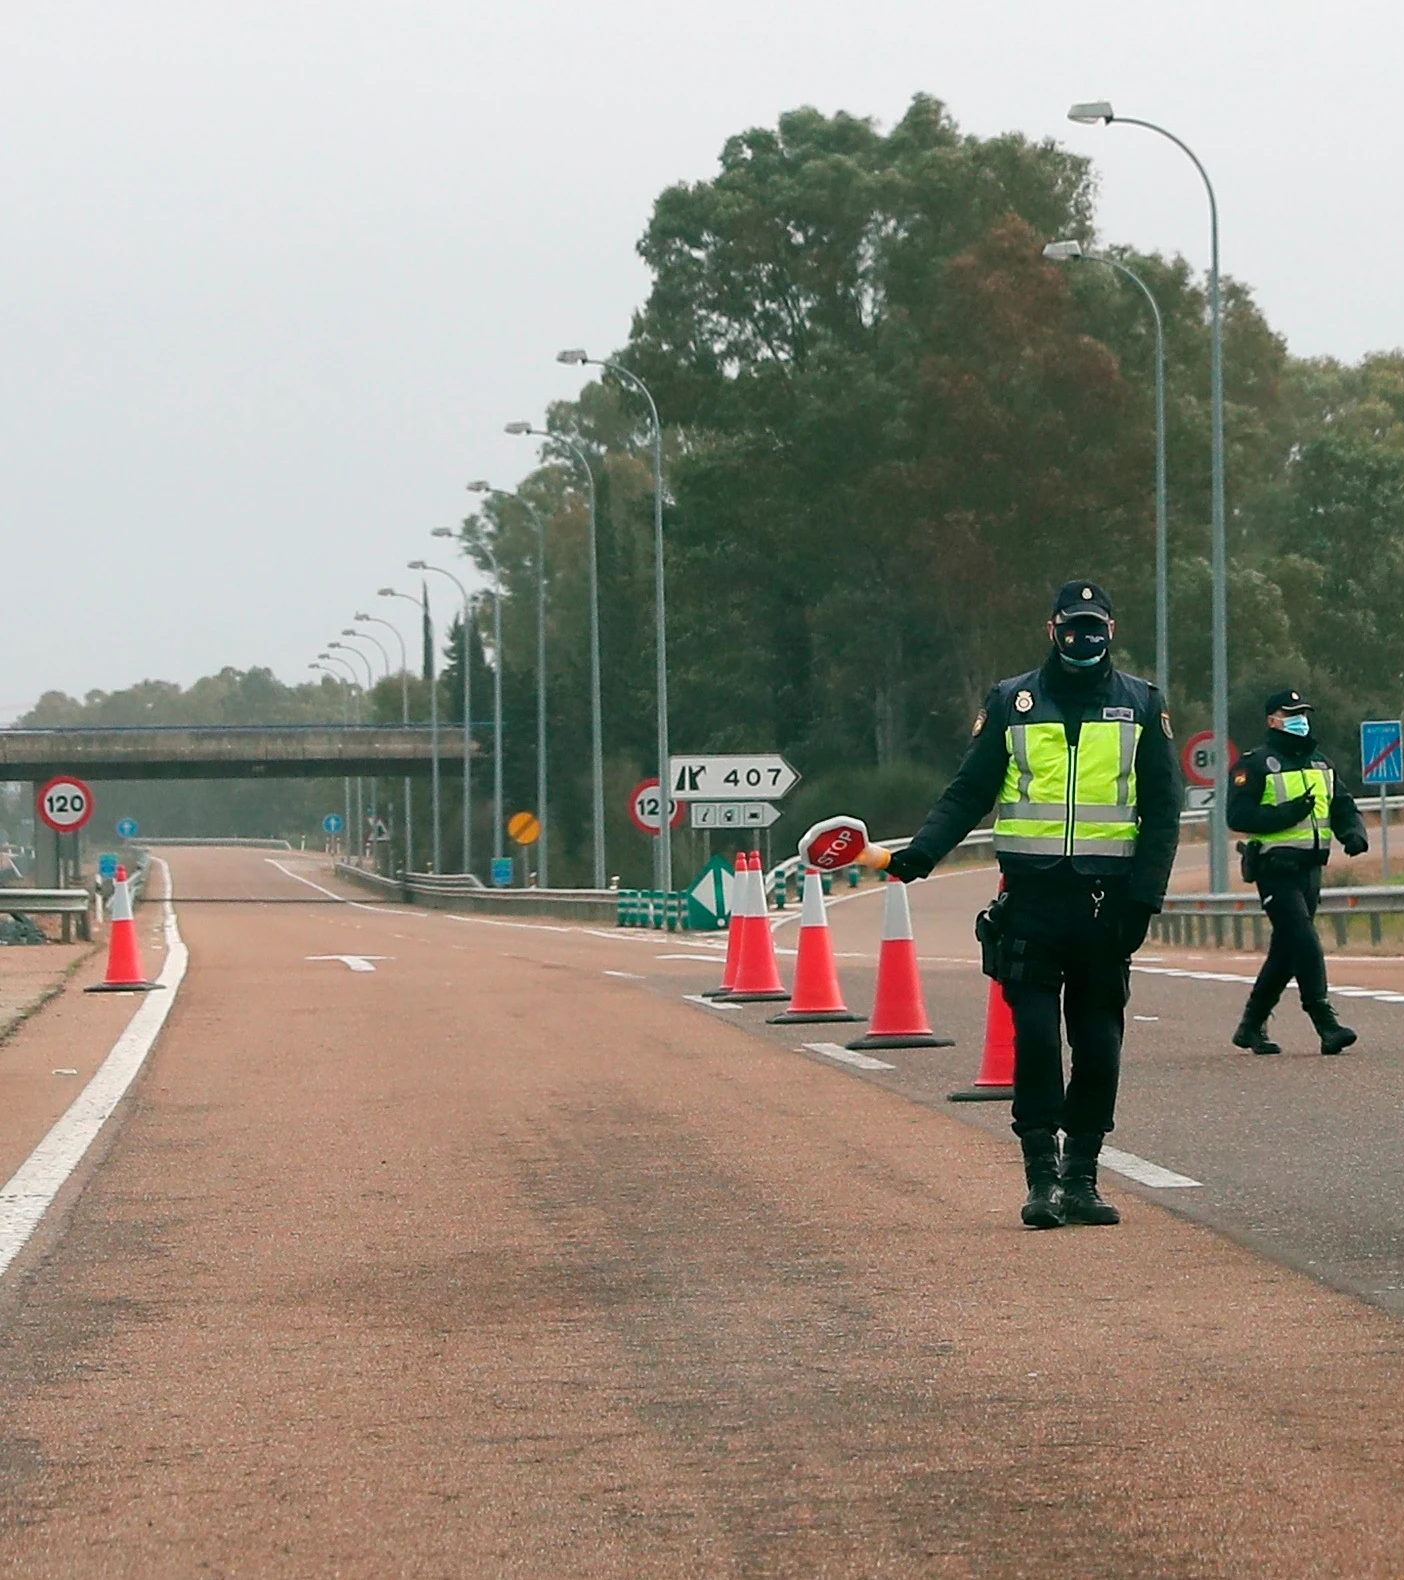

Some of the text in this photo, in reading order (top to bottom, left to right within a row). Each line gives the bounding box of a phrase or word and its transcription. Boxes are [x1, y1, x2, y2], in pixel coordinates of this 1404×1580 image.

[724, 768, 782, 787] 407
[46, 795, 84, 813] 120
[817, 830, 853, 866] STOP
